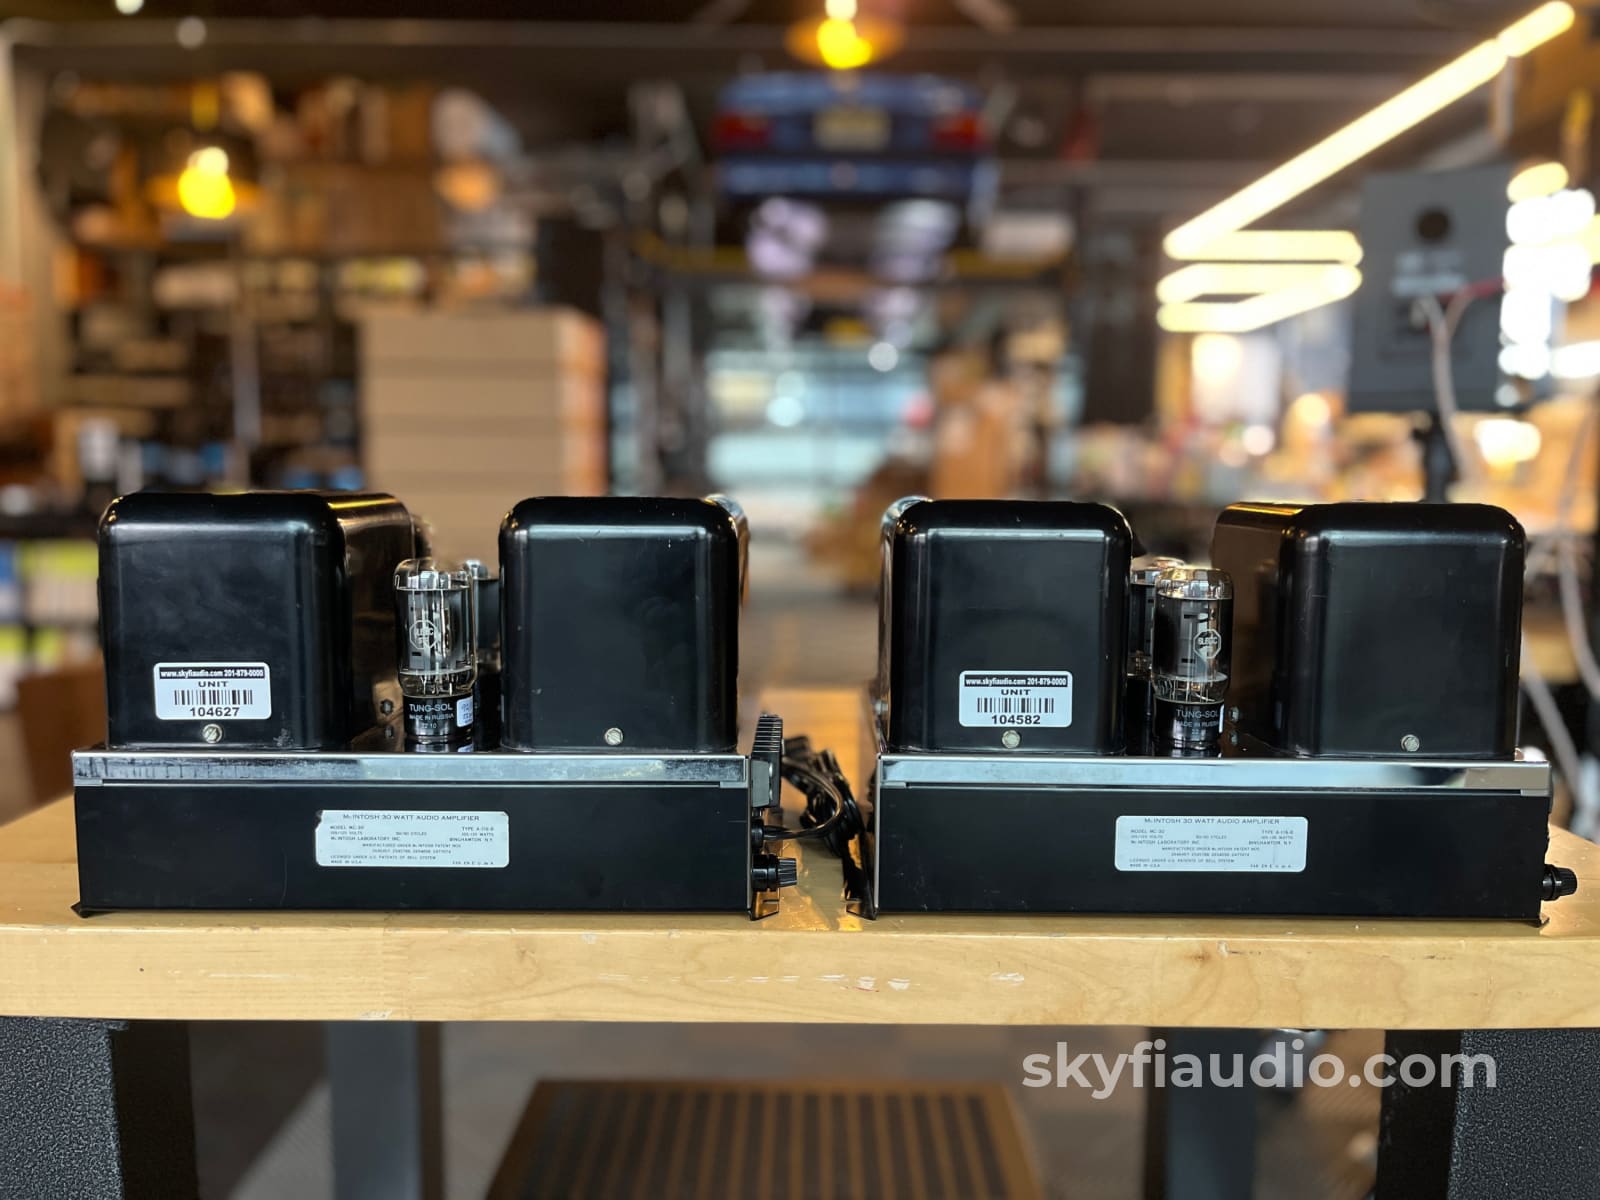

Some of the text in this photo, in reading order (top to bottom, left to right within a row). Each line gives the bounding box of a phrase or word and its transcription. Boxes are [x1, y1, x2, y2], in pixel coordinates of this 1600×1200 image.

[160, 669, 224, 678] www.skyfiaudio.com
[966, 677, 1066, 686] www.skyfiaudio.com 201-879-0000
[190, 707, 240, 717] 104627
[409, 704, 453, 712] TUNG-SOL
[992, 715, 1040, 724] 104582
